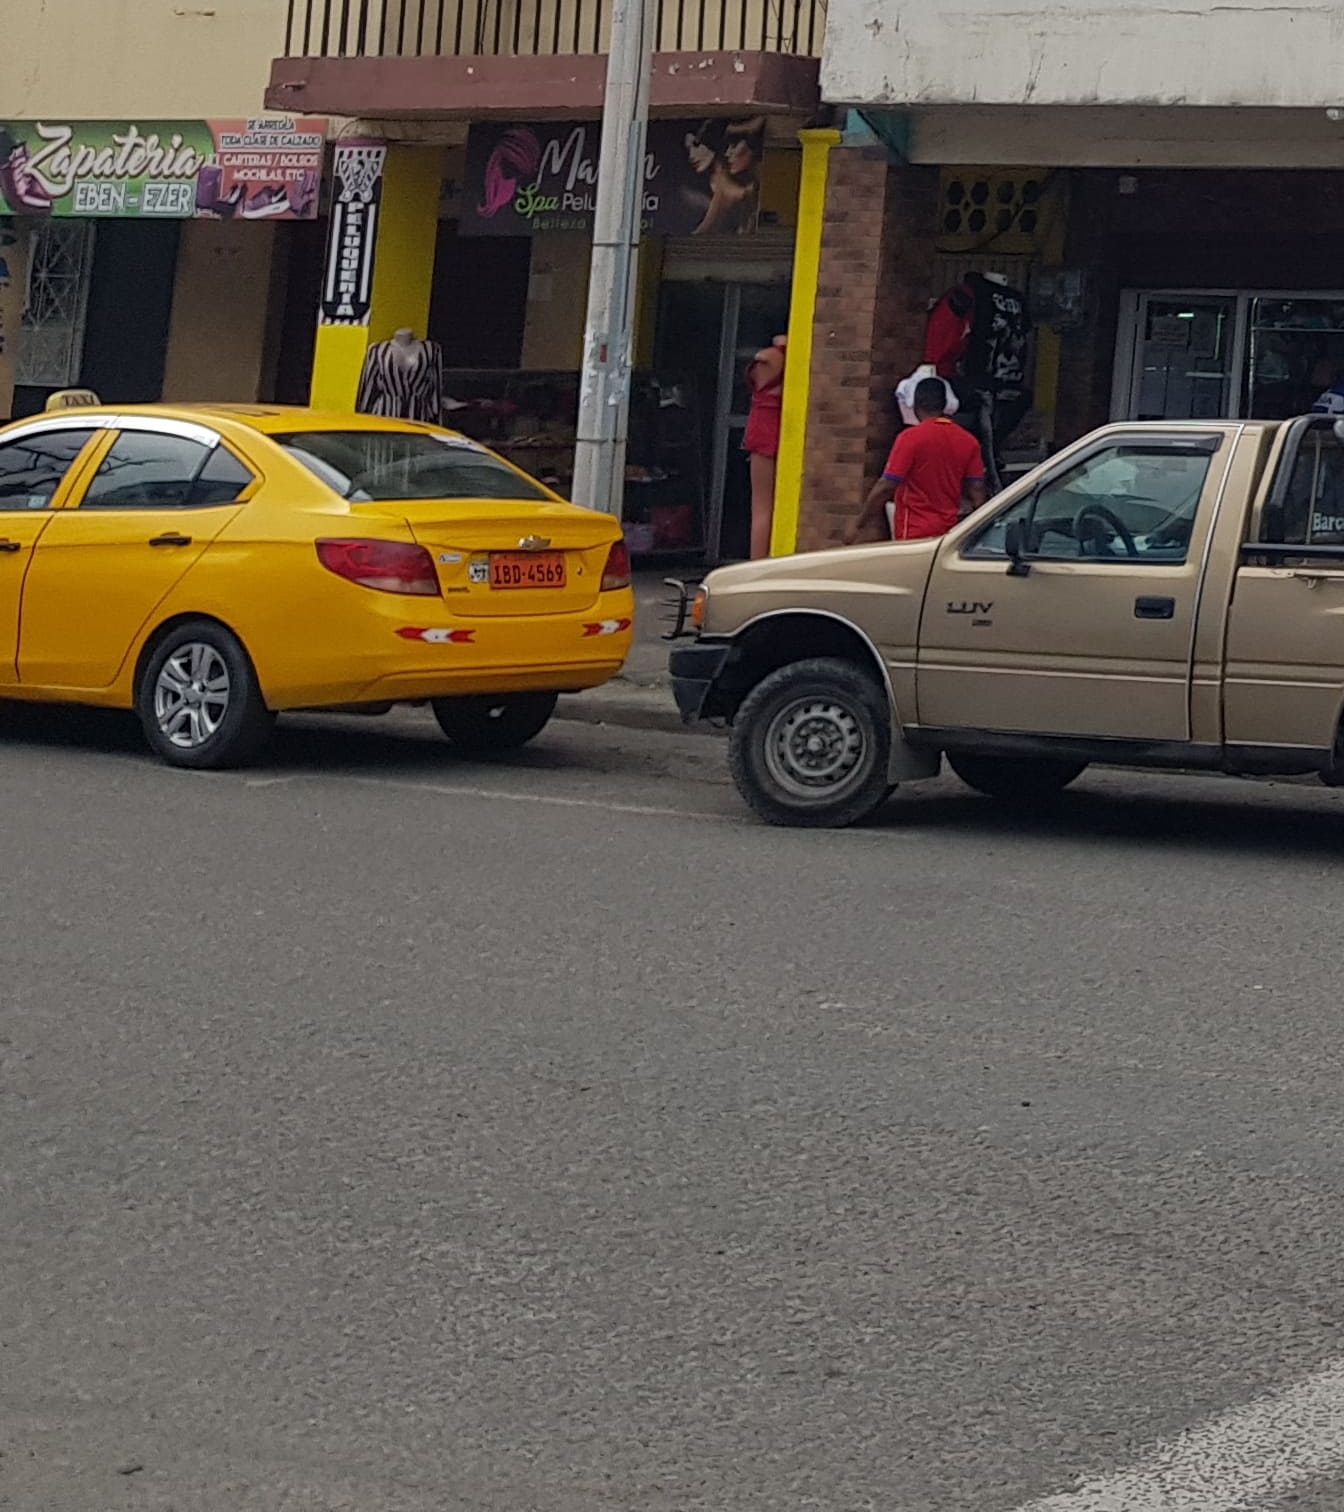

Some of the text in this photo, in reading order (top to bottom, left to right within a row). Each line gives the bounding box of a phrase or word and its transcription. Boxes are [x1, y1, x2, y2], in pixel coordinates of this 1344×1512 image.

[269, 135, 279, 145] DE
[280, 135, 320, 146] CALZADO
[223, 153, 272, 166] CARTERAS
[280, 154, 318, 166] BOLSOS
[75, 183, 125, 211] EBEN
[143, 183, 192, 212] EZER
[515, 183, 559, 218] Spa
[61, 393, 96, 407] TAXI
[946, 600, 994, 615] LUV
